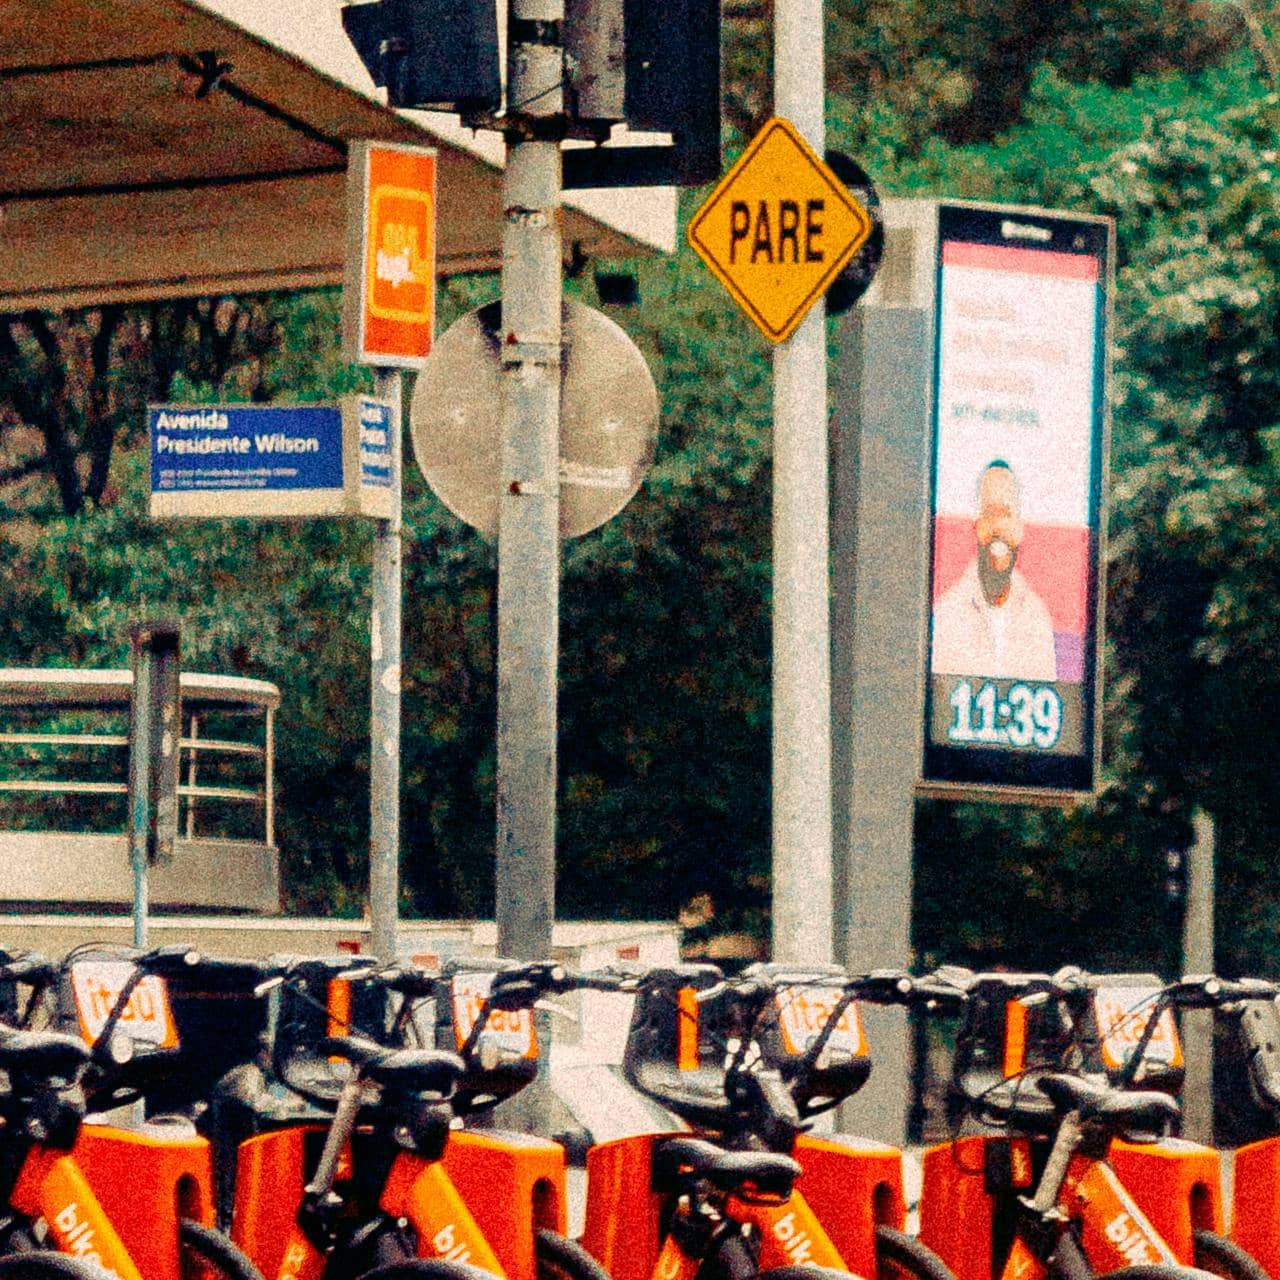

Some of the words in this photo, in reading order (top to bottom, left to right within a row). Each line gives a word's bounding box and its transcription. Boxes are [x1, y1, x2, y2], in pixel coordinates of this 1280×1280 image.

[729, 199, 824, 264] PARE
[156, 410, 229, 430] Avenida
[157, 434, 250, 454] Presidente
[255, 433, 320, 453] Wilson
[949, 680, 1062, 748] 11:39
[773, 1212, 817, 1267] bik
